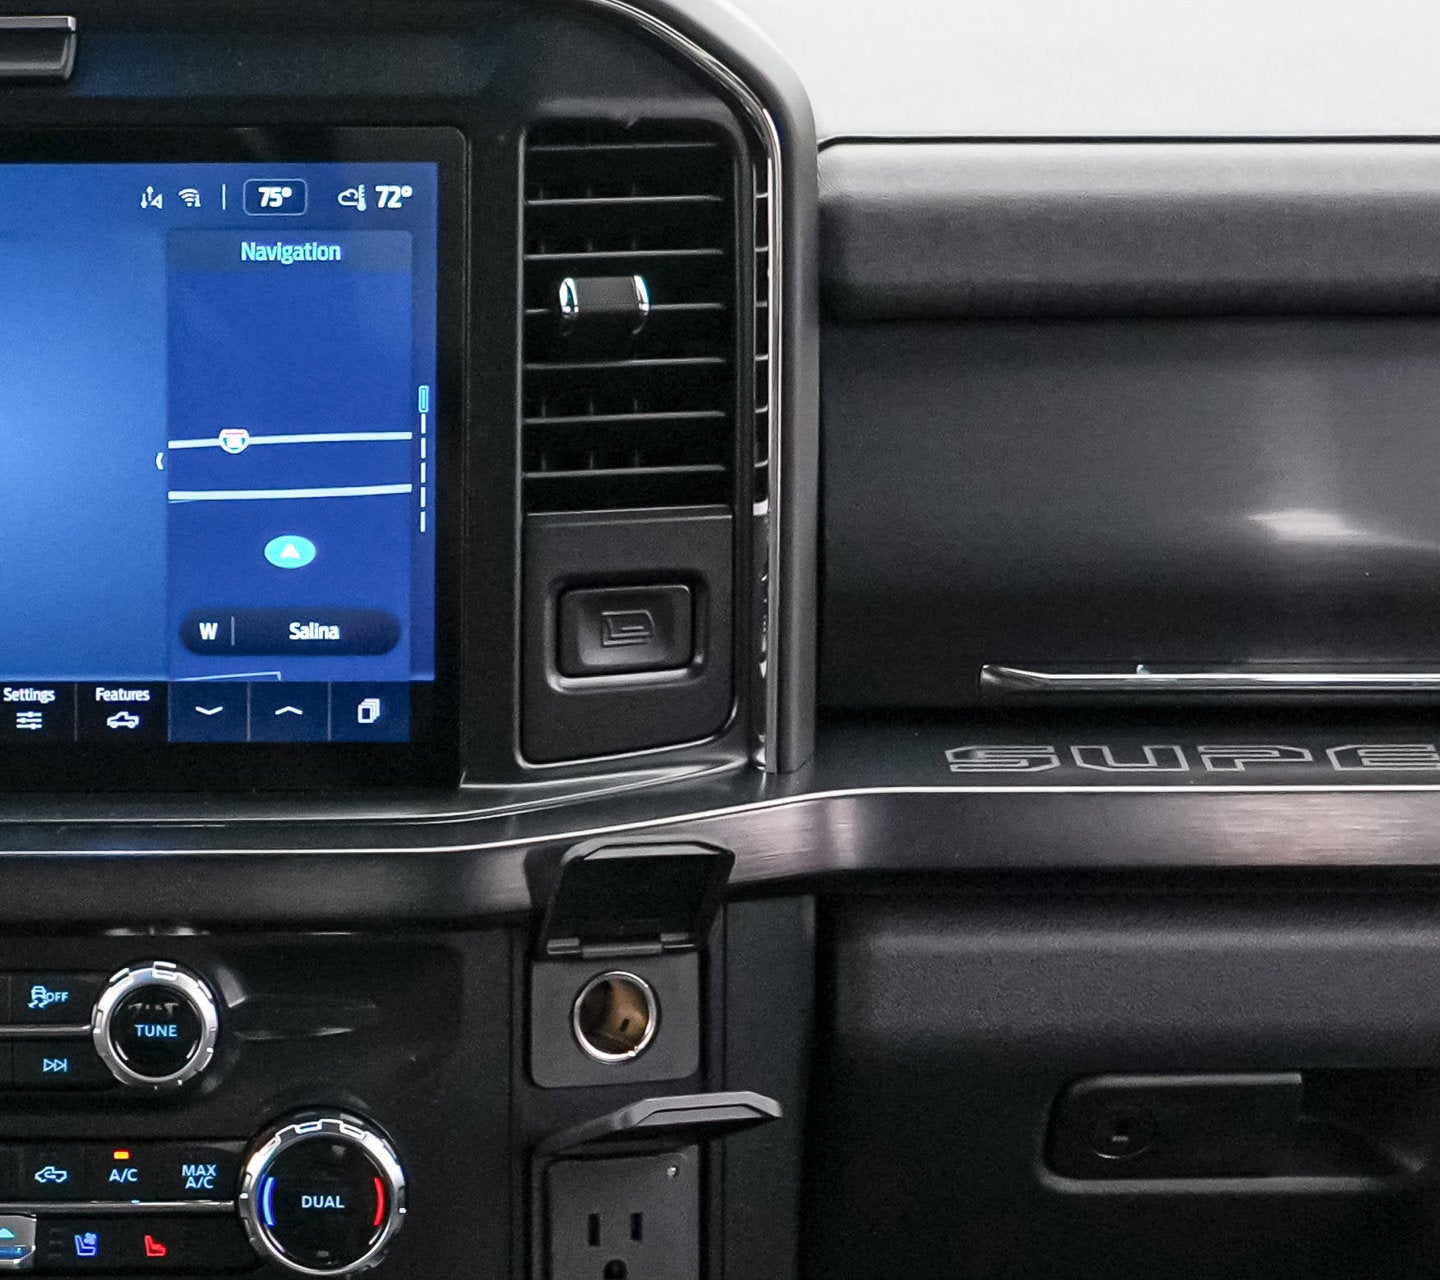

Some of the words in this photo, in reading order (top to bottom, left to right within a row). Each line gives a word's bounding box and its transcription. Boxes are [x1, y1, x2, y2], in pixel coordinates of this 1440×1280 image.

[240, 241, 341, 266] Navigation
[198, 622, 218, 639] W
[288, 621, 340, 640] Salina
[2, 686, 56, 706] Settings
[94, 686, 151, 703] Features
[44, 990, 70, 1004] OFF
[134, 1023, 179, 1039] TUNE
[108, 1167, 139, 1184] A/C
[182, 1163, 217, 1177] MAX
[184, 1175, 215, 1192] A/C
[300, 1194, 346, 1210] DUAL
